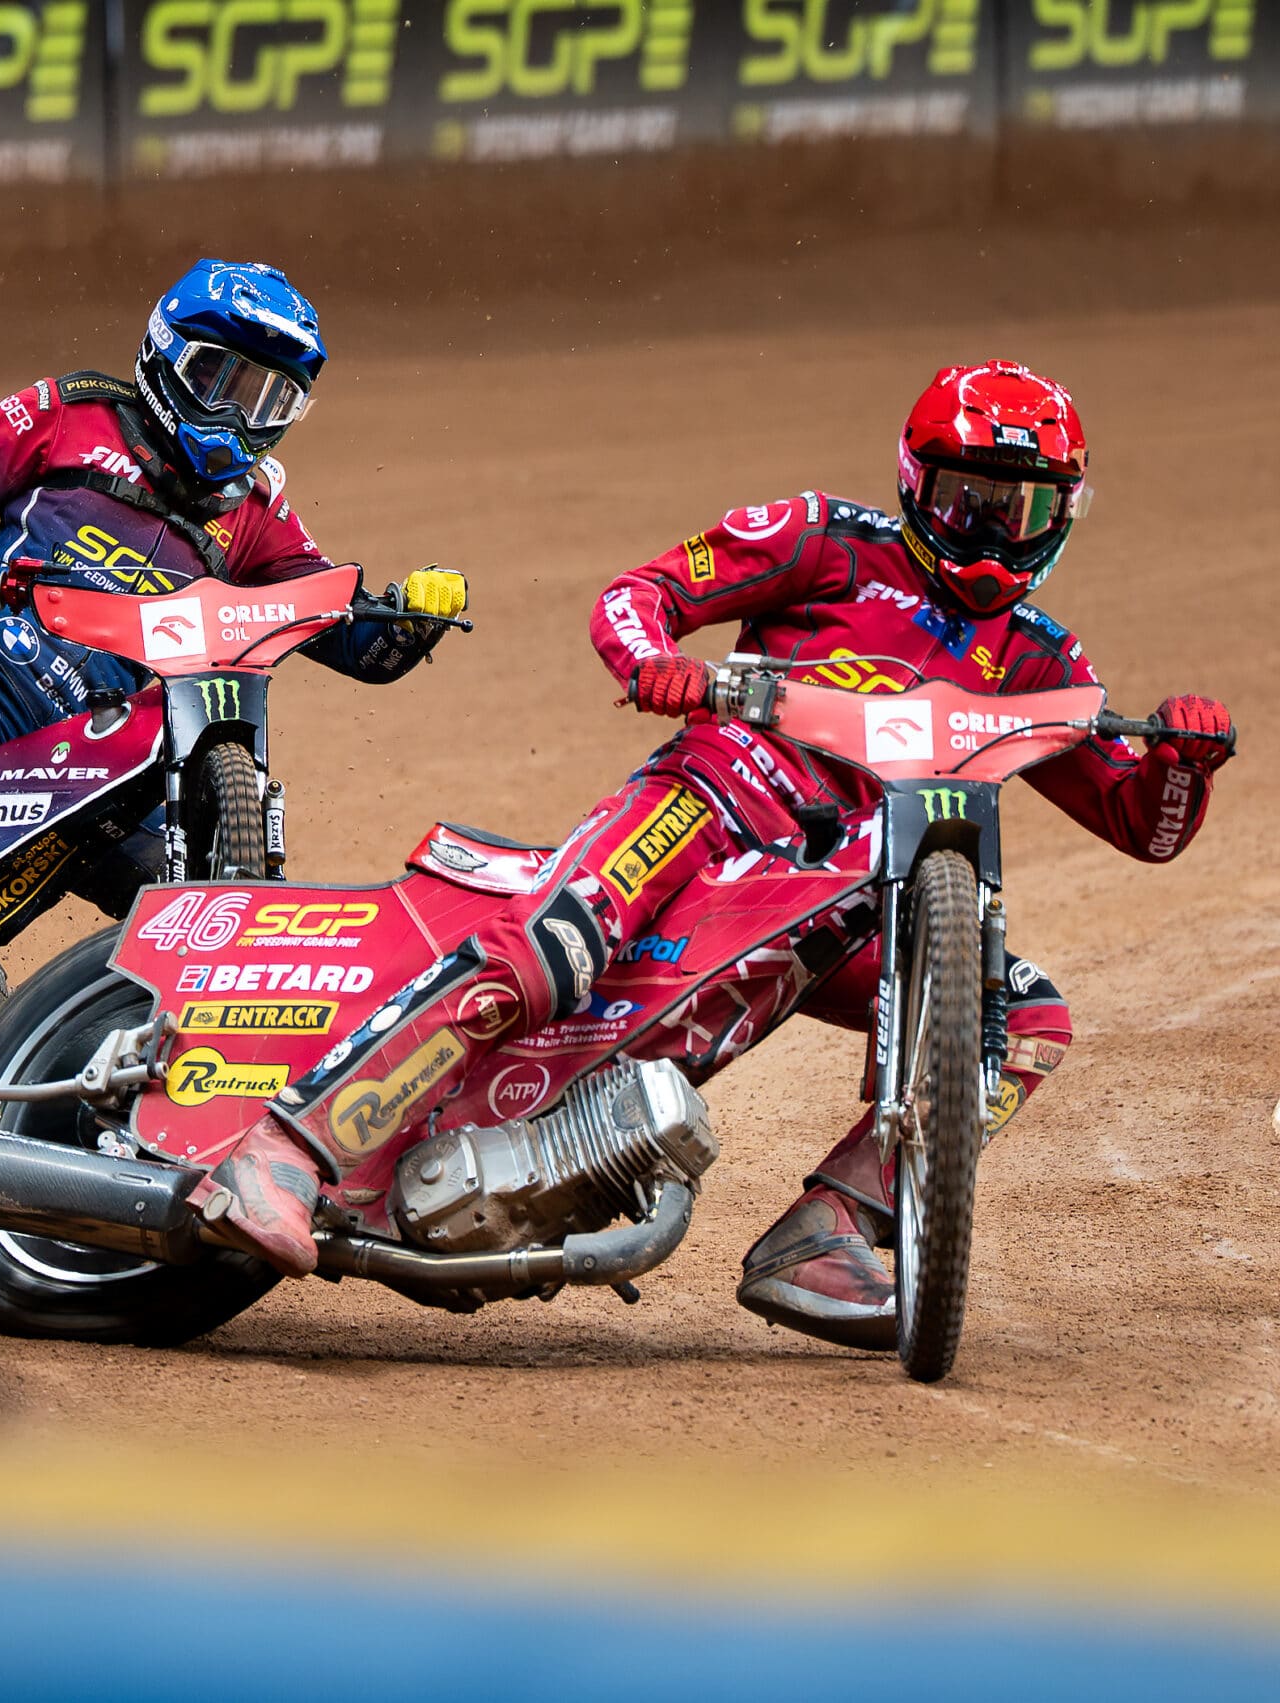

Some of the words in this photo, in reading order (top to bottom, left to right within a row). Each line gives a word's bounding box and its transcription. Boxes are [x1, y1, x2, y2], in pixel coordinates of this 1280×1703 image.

[78, 446, 143, 484] FIM
[217, 603, 296, 624] ORLEN
[221, 628, 251, 641] OIL
[50, 655, 89, 703] BMW
[948, 711, 1033, 738] ORLEN
[950, 734, 982, 751] OIL
[0, 768, 110, 780] MAVER
[1148, 767, 1192, 858] BETARD
[136, 891, 253, 952] 46
[243, 903, 380, 937] SGP
[253, 937, 303, 947] SPEEDWAY
[303, 937, 337, 948] GRAND
[337, 937, 361, 948] PRIX
[208, 964, 375, 994] BETARD
[226, 1007, 323, 1027] ENTRACK
[179, 1063, 281, 1094] Rentruck
[498, 1082, 541, 1101] ATPI
